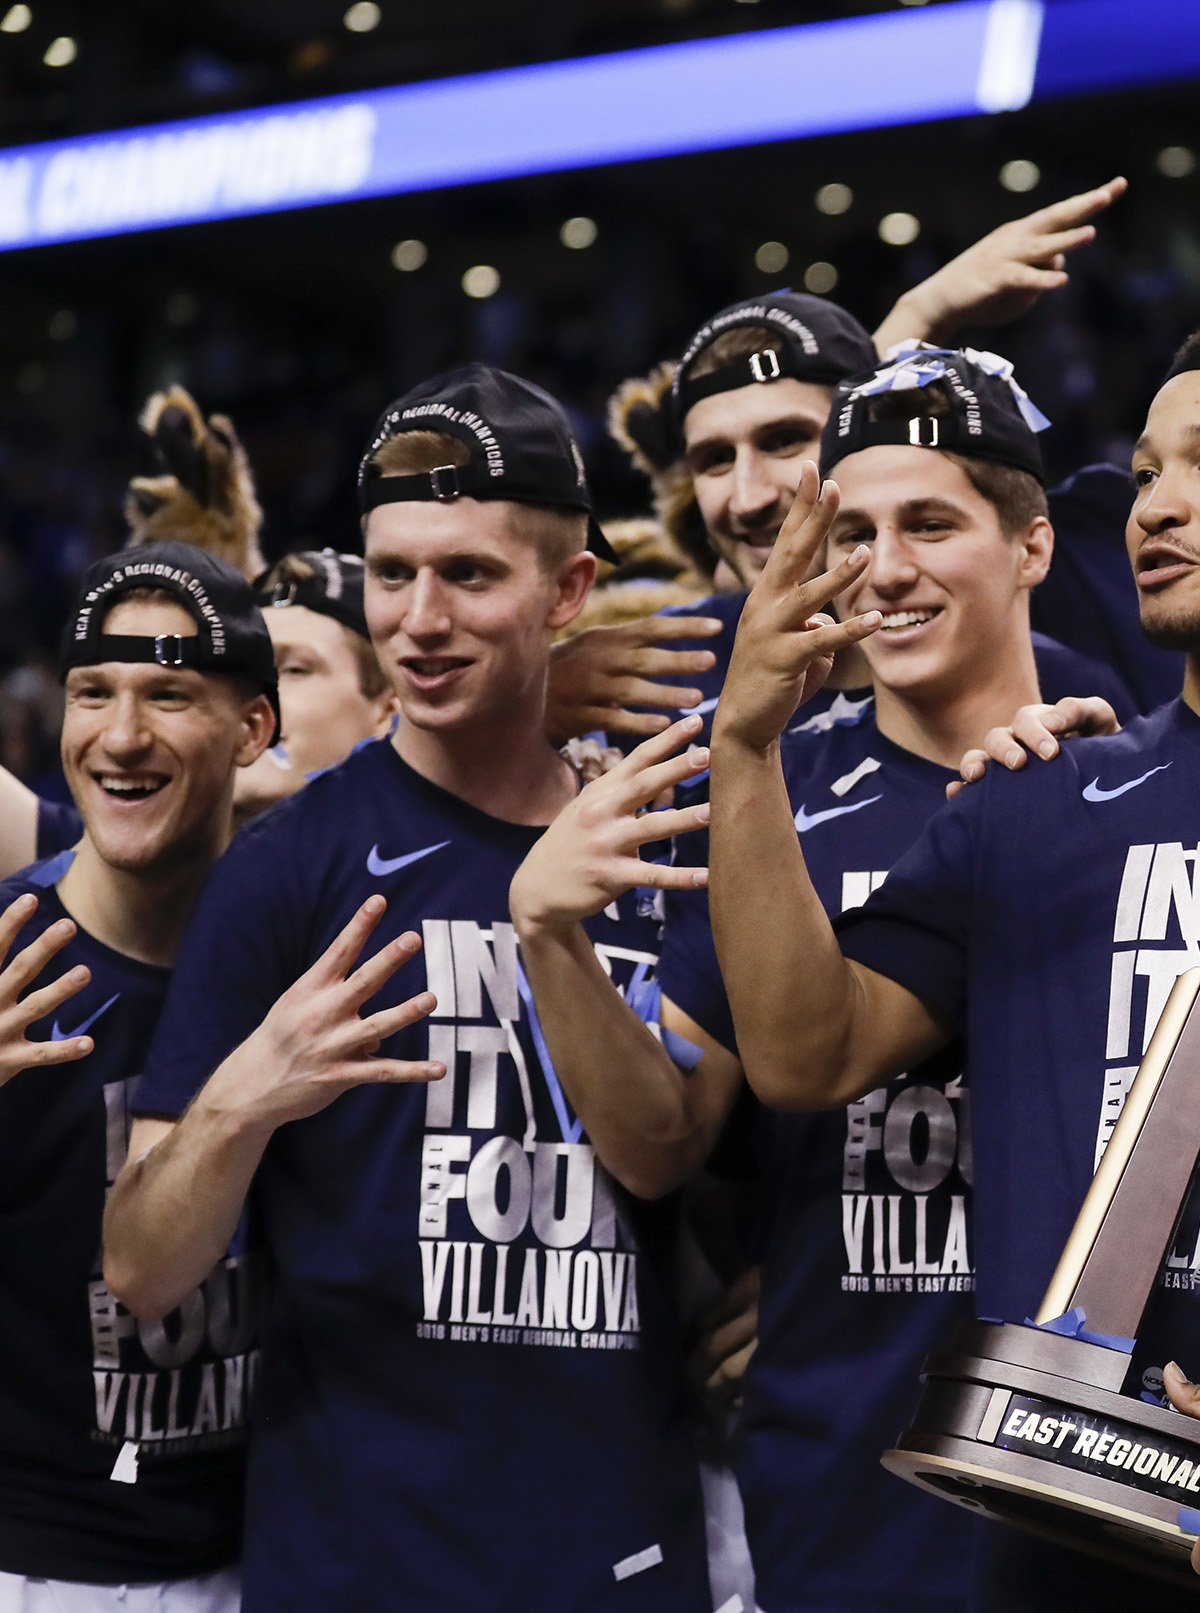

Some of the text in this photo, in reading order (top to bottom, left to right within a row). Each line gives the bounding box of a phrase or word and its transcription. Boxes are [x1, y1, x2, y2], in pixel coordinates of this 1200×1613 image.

[946, 367, 983, 436] CHAMPIONS
[402, 403, 460, 422] REGIONAL
[458, 411, 505, 478] CHAMPIONS
[75, 607, 92, 641] NCAA
[422, 919, 521, 1022] IN
[425, 1024, 509, 1130] IT
[1101, 1079, 1123, 1161] INAL
[425, 1146, 444, 1224] FINAL
[841, 1194, 976, 1275] VILLA
[418, 1240, 641, 1333] VILLANOVA
[841, 1275, 870, 1292] 2018
[874, 1277, 914, 1293] MEN'S
[916, 1277, 946, 1293] EAST
[450, 1325, 490, 1344] MEN'S
[492, 1328, 521, 1346] EAST
[1002, 1409, 1076, 1449] EAST
